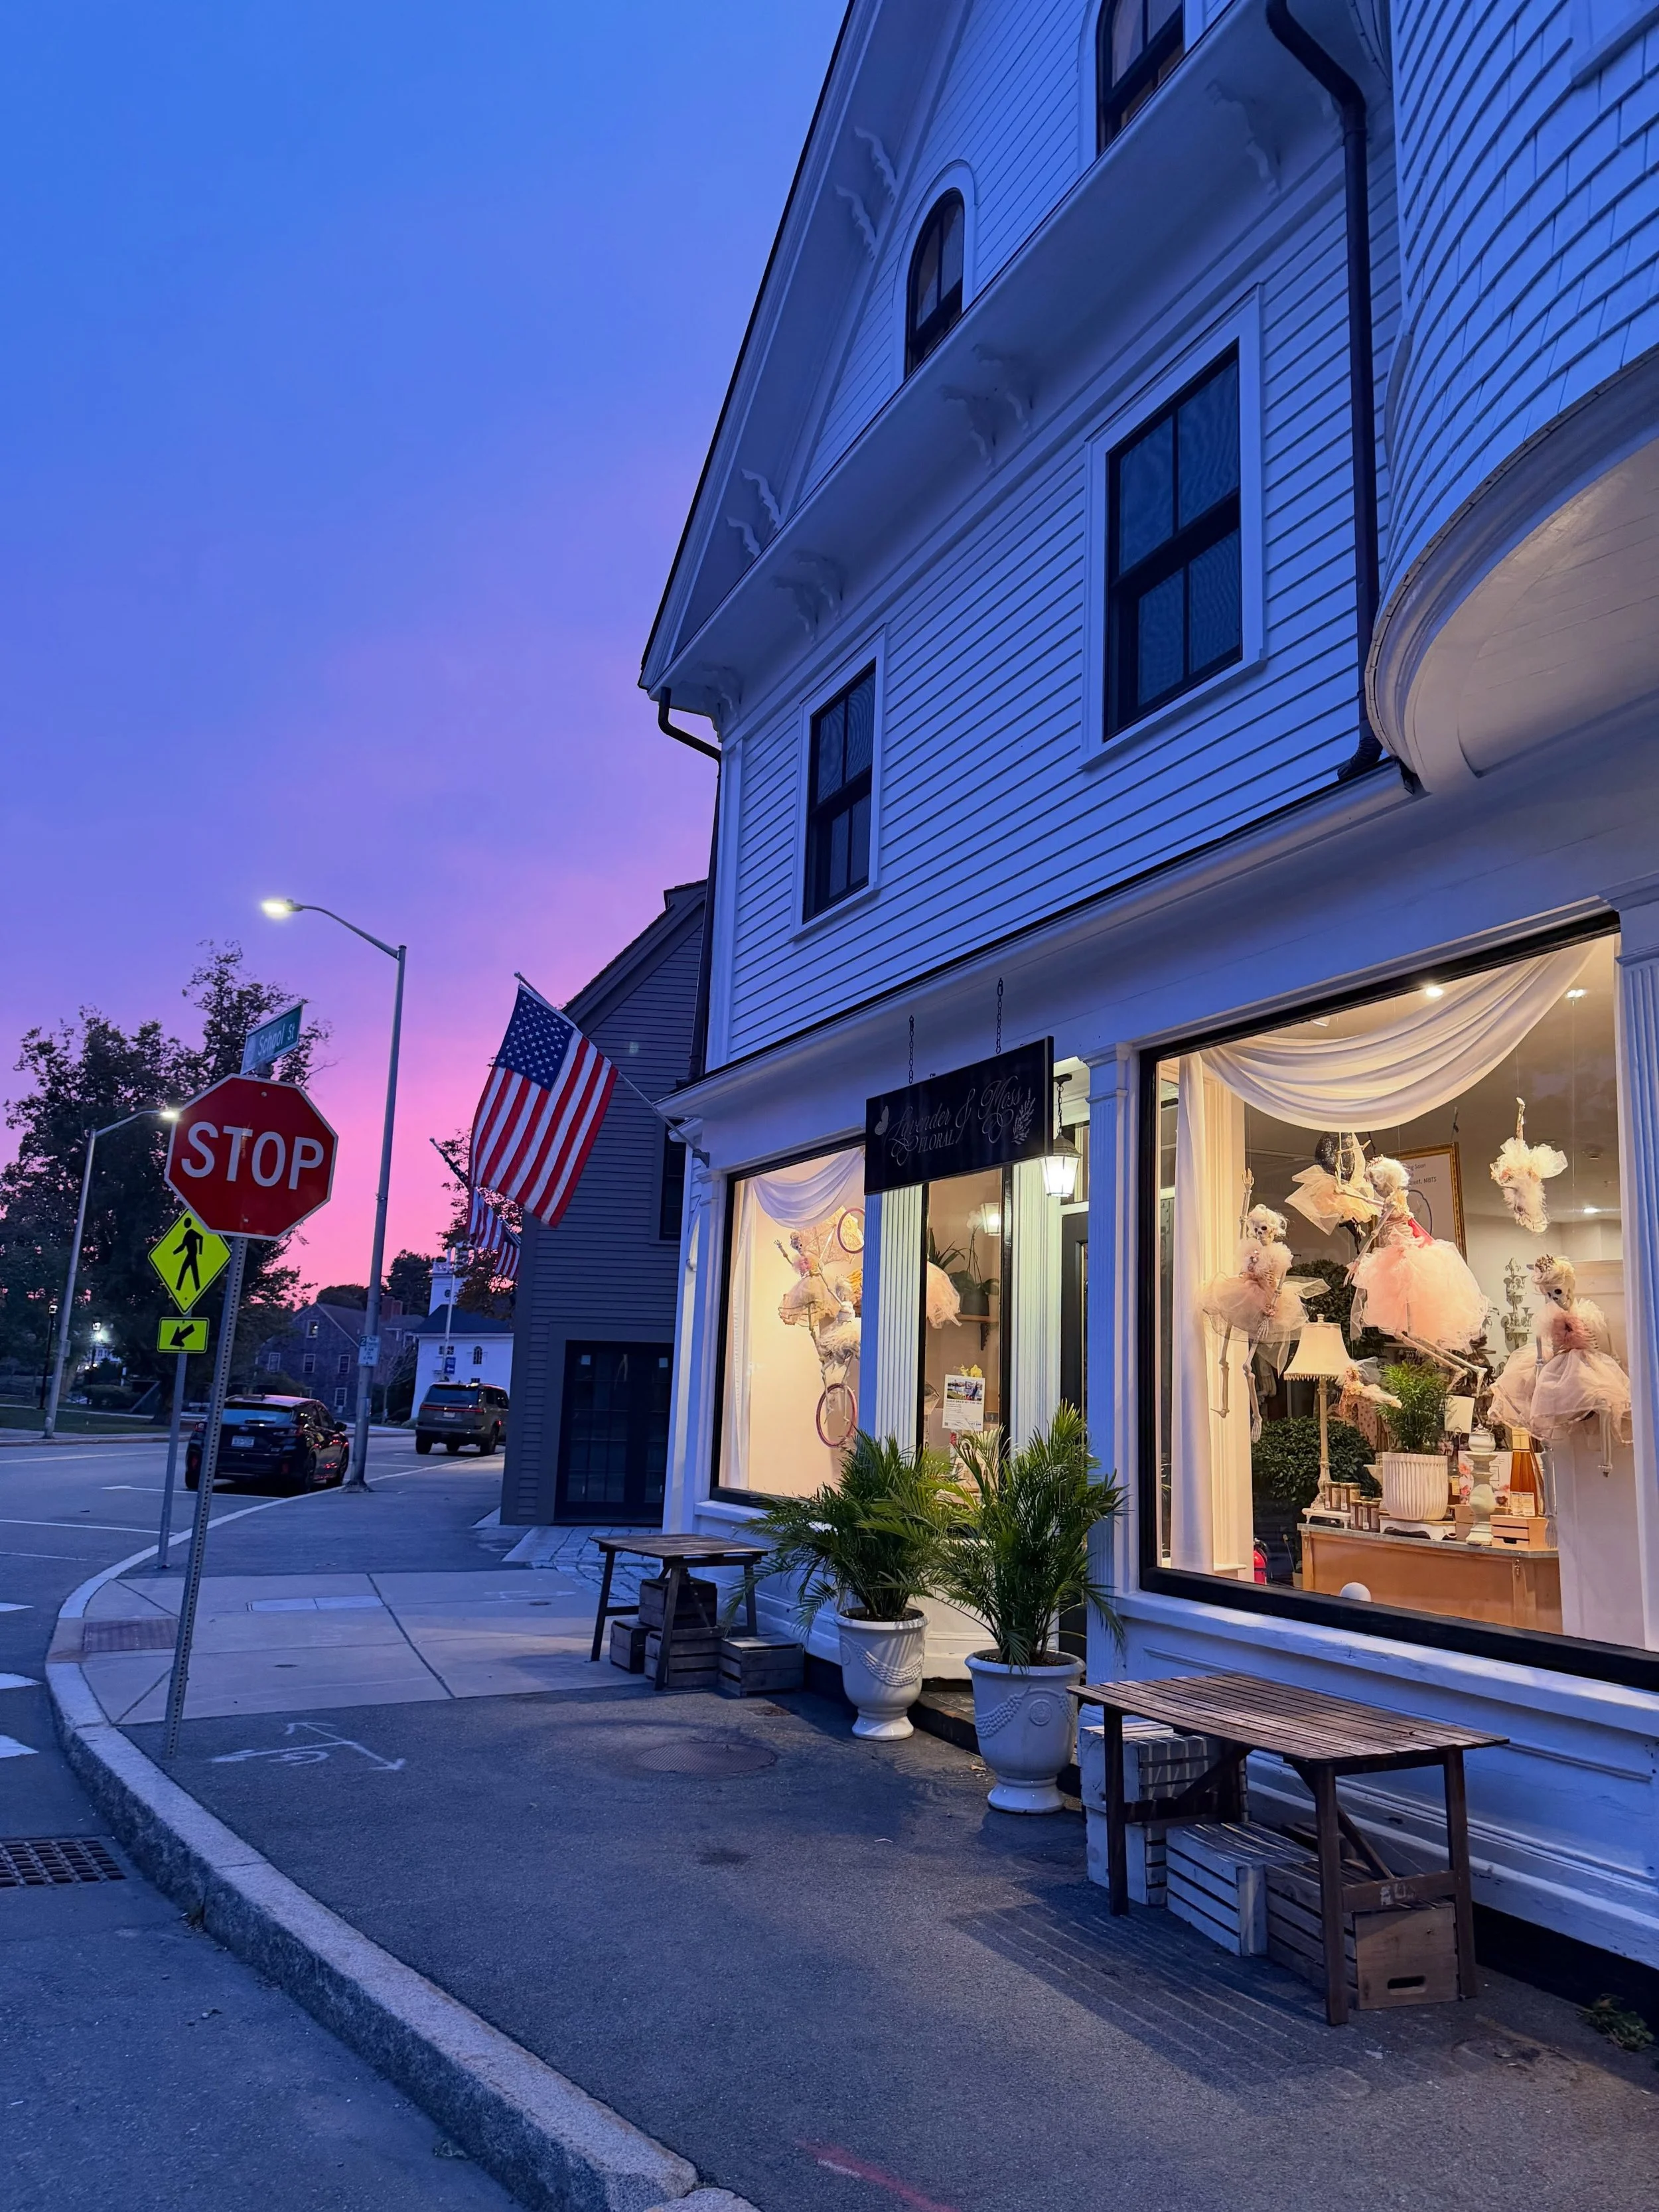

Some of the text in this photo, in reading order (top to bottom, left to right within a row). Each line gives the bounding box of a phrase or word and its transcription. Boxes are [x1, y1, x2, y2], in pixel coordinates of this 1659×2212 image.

[258, 1023, 295, 1056] School St
[888, 1103, 953, 1166] Lavender
[978, 1075, 1023, 1143] Moss
[917, 1130, 956, 1153] FLORAL
[181, 1122, 324, 1190] STOP
